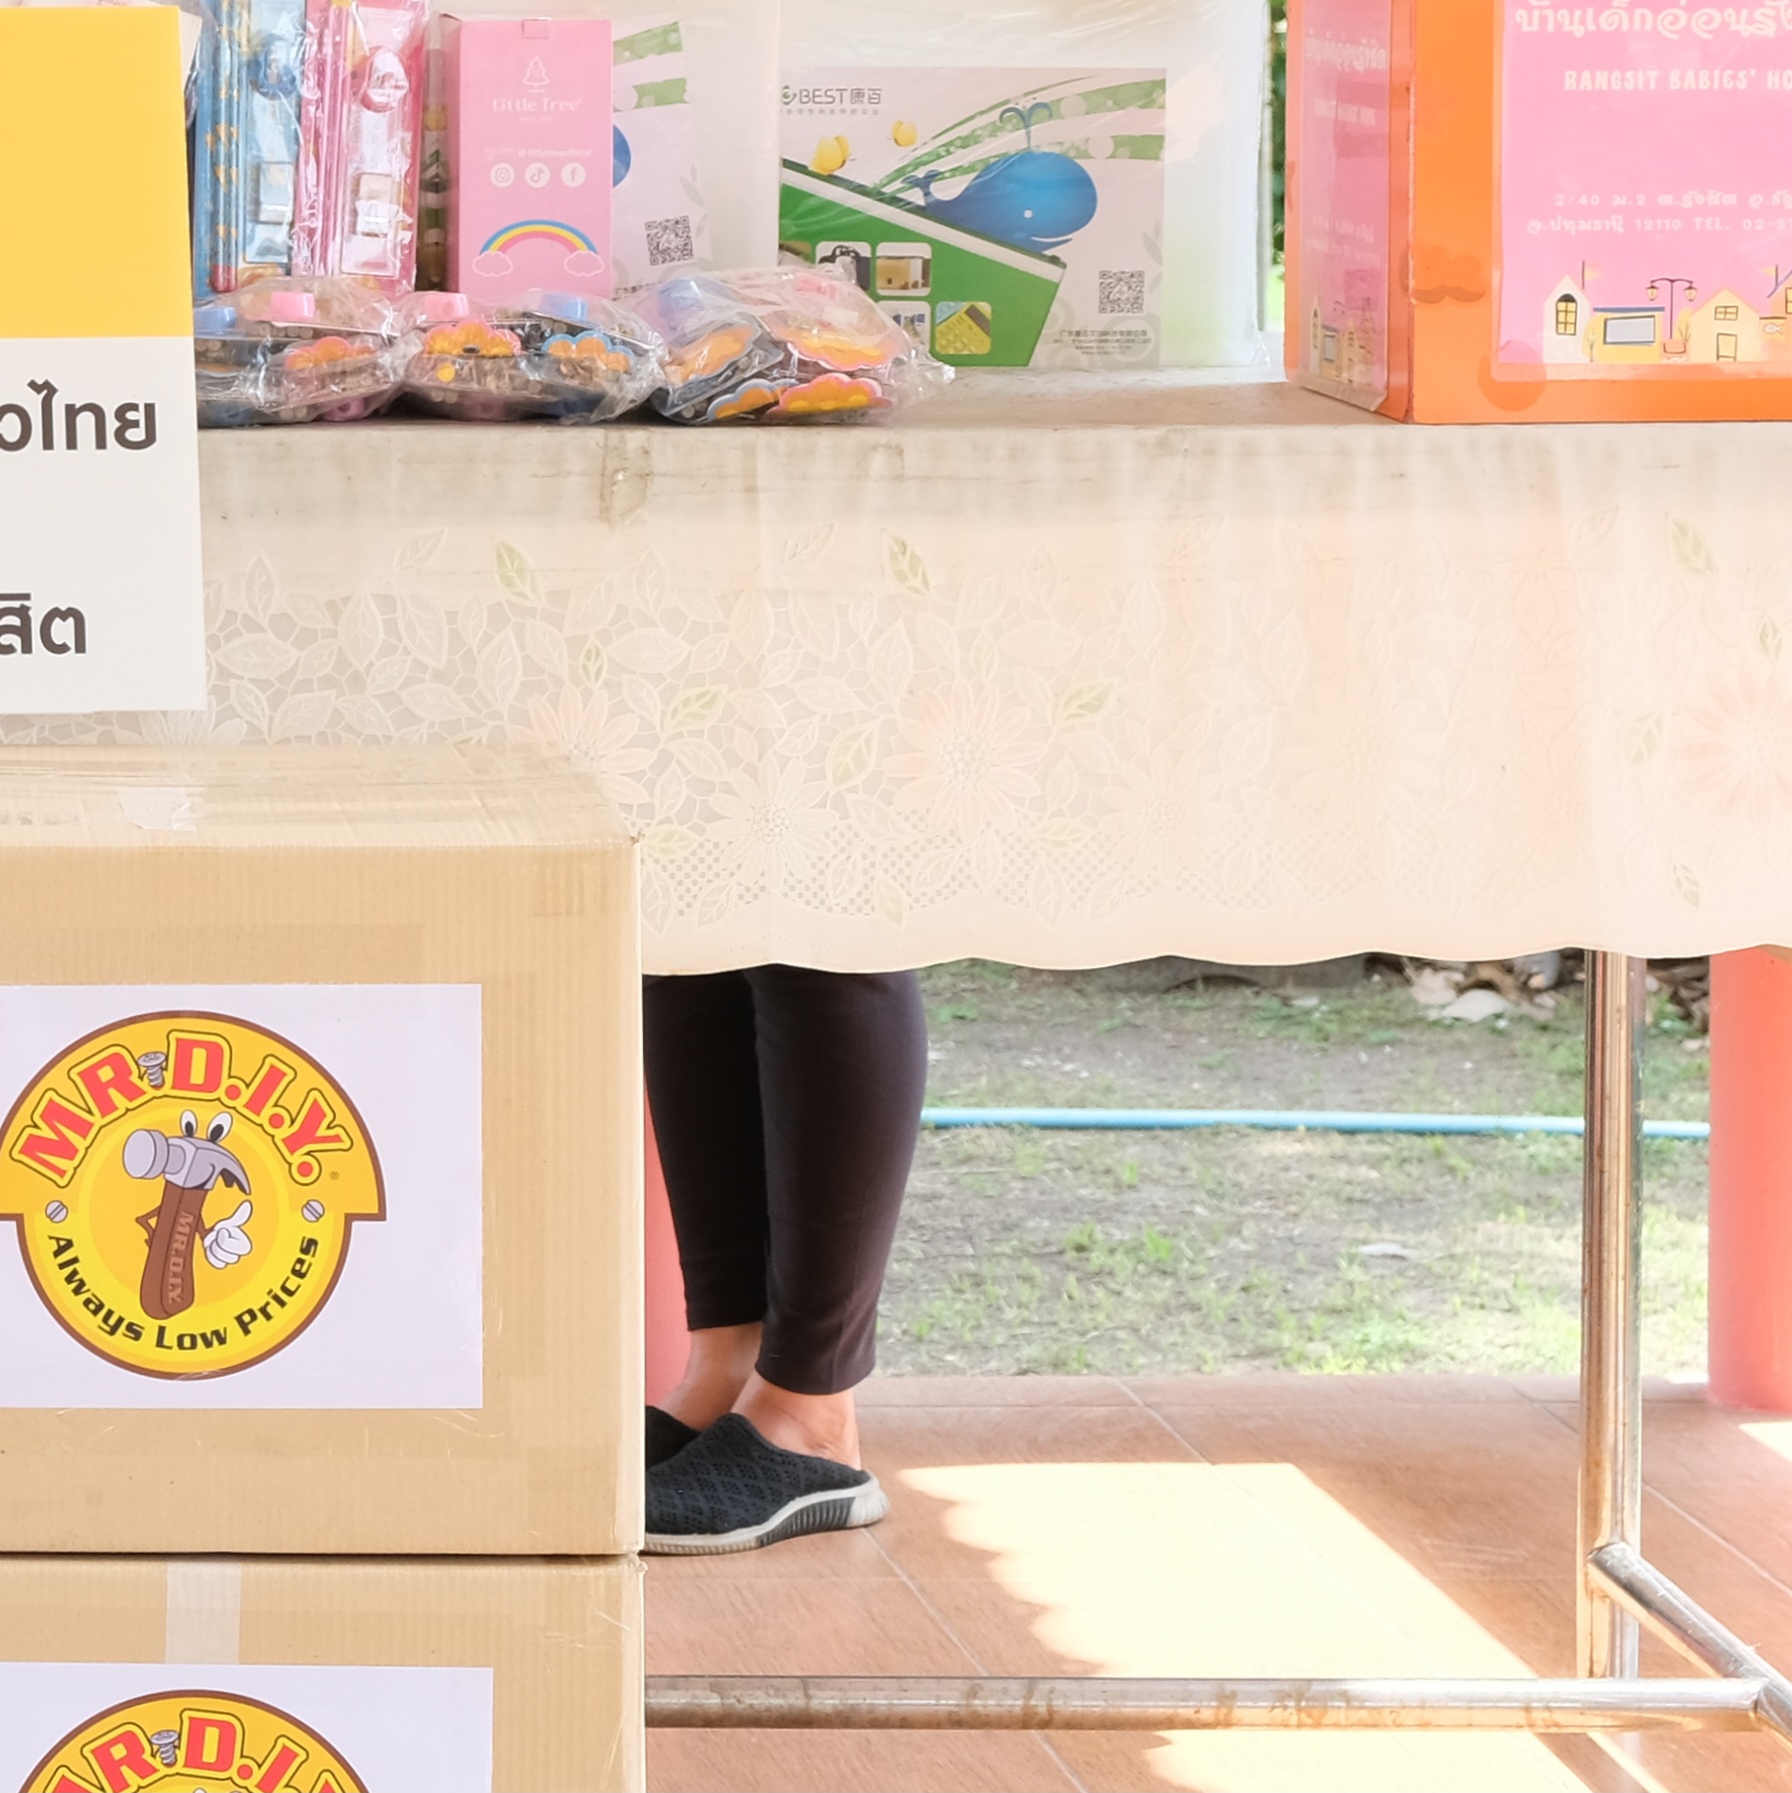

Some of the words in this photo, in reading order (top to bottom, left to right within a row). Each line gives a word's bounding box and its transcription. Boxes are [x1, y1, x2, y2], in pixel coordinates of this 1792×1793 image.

[1565, 69, 1659, 91] RANGSIT
[492, 98, 538, 111] Little
[1555, 194, 1601, 206] 2/40
[1635, 218, 1682, 231] 12110
[1693, 217, 1730, 231] TEL.
[47, 1233, 145, 1342] Always
[154, 1325, 227, 1351] Low
[233, 1235, 319, 1337] Prices
